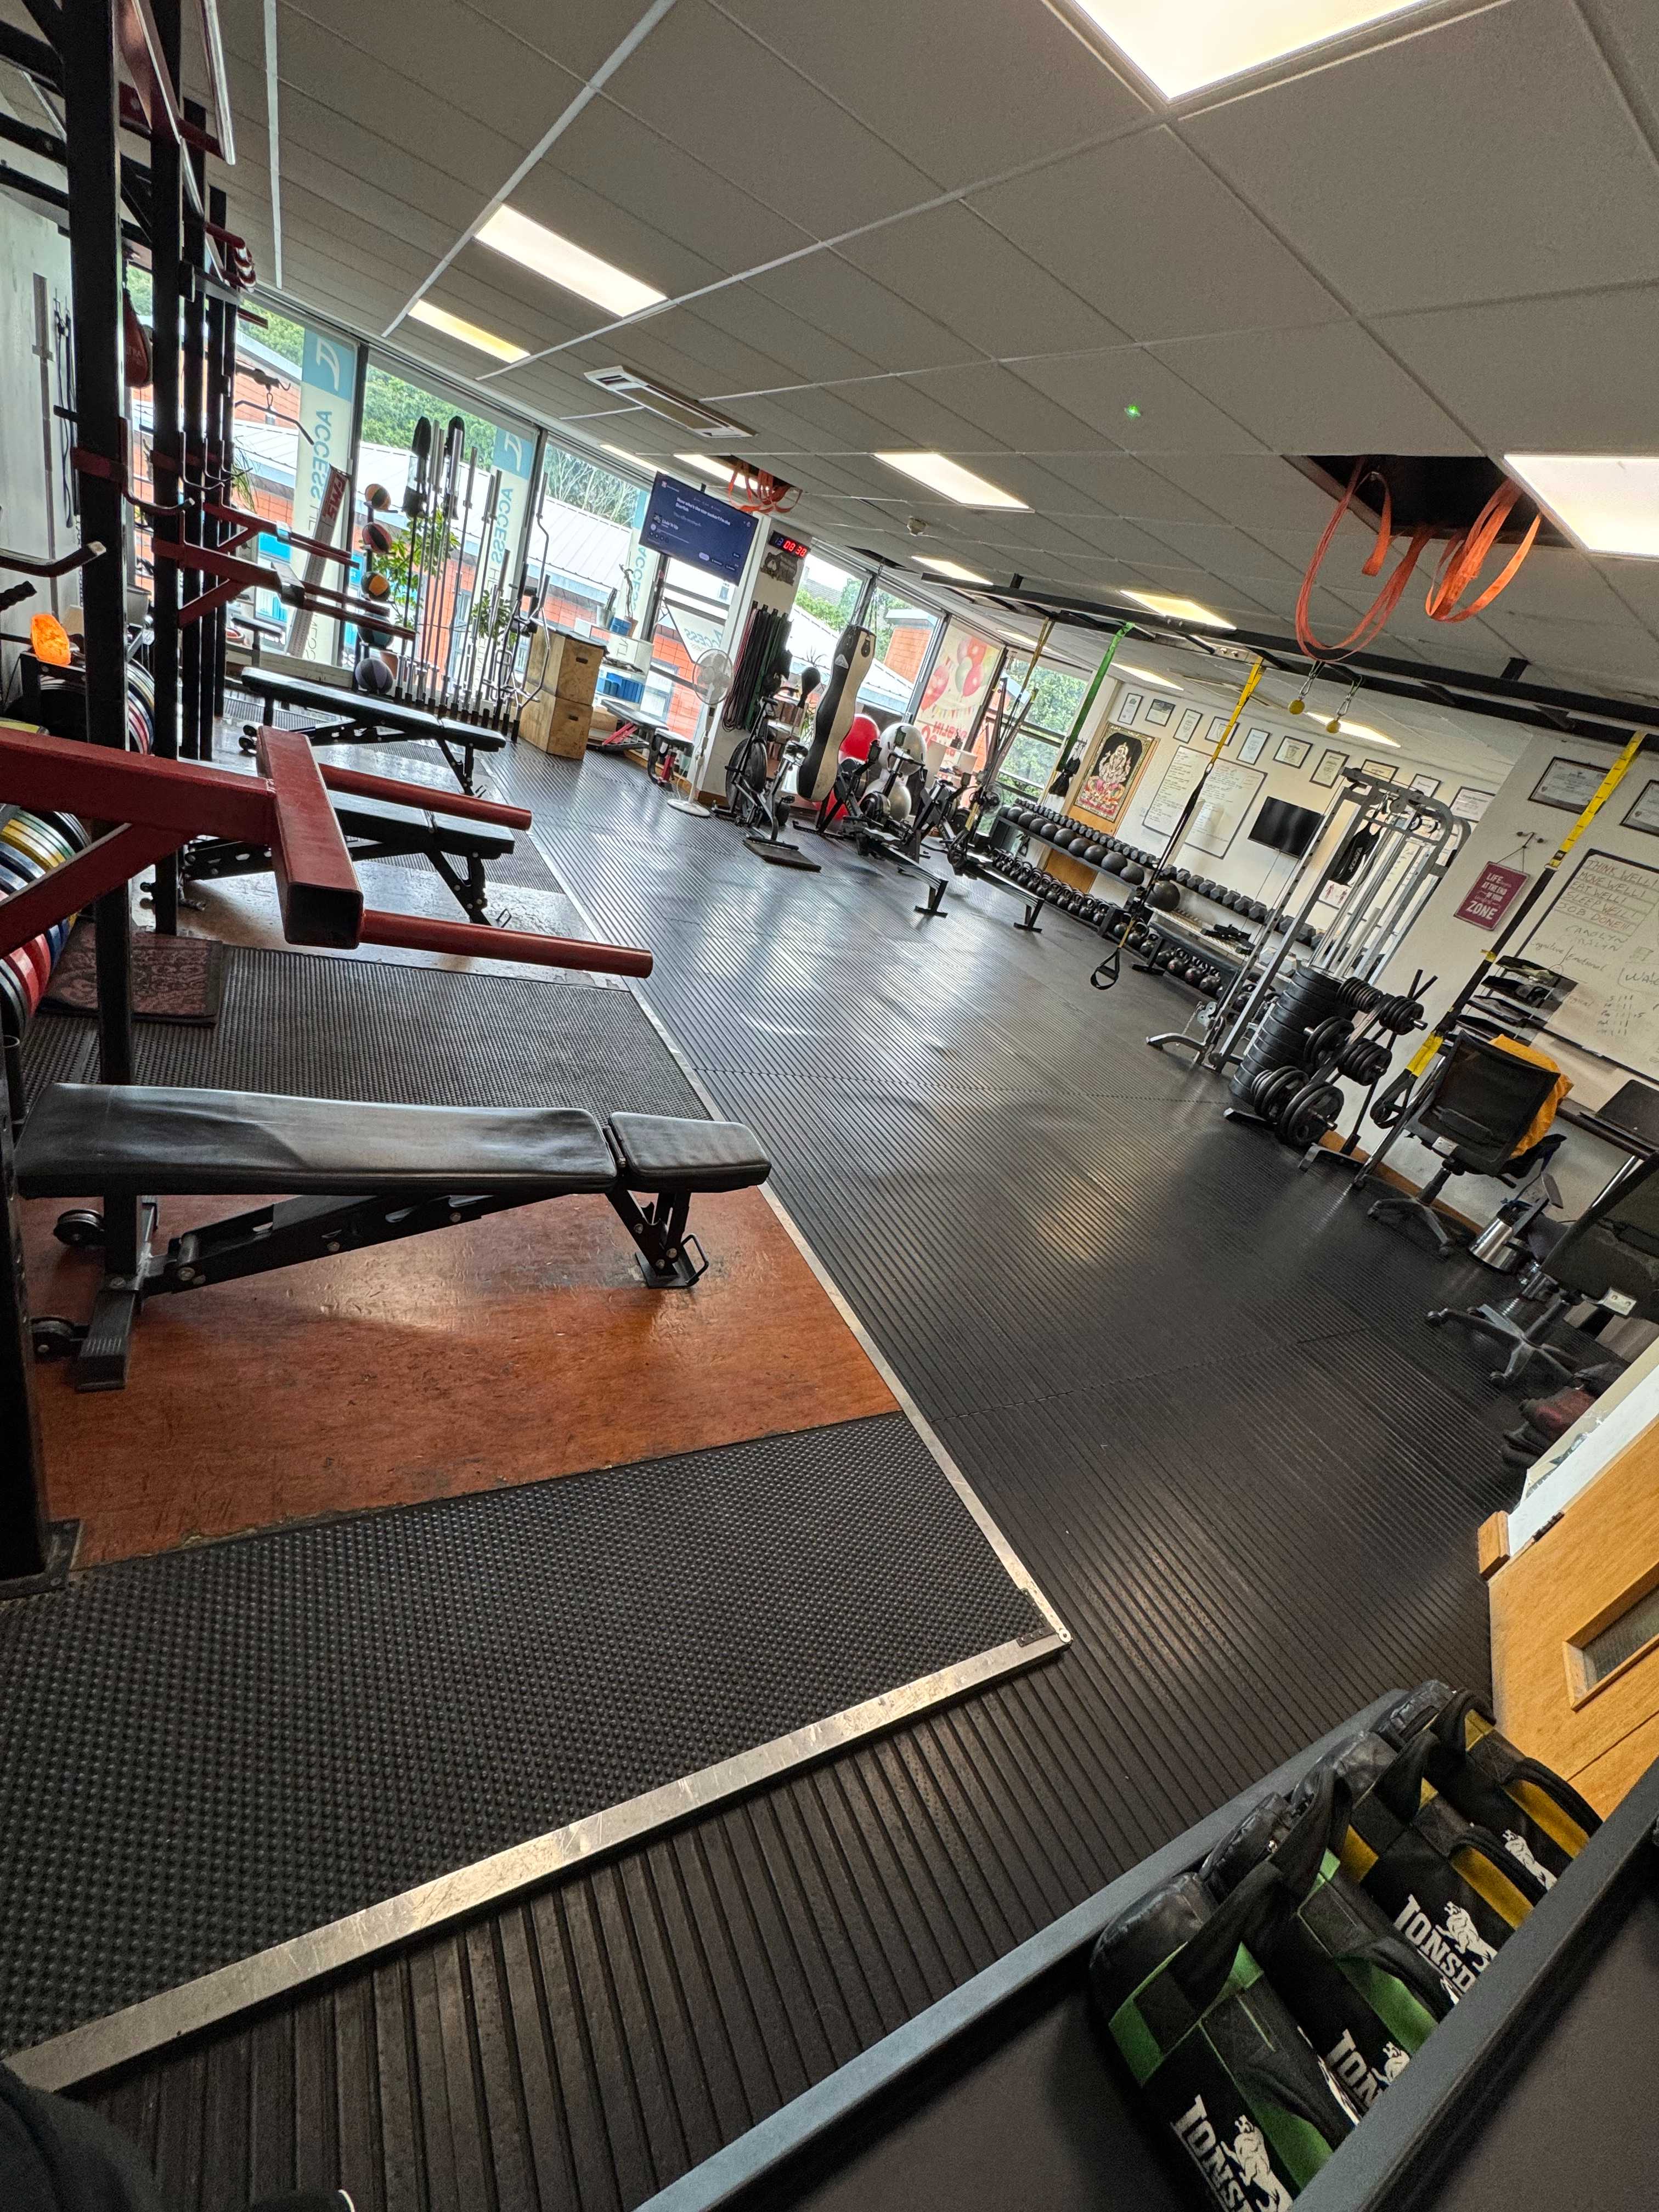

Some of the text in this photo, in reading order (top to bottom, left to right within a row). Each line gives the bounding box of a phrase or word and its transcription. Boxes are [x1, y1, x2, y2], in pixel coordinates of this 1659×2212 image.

[1588, 860, 1618, 876] THINK
[1486, 873, 1504, 884] LIFE
[1579, 871, 1603, 885] MOVE
[1571, 881, 1590, 893] EAT
[1564, 891, 1601, 911] SLEEP
[1466, 900, 1498, 920] ZONE
[1557, 902, 1630, 930] JOB DONE!!!
